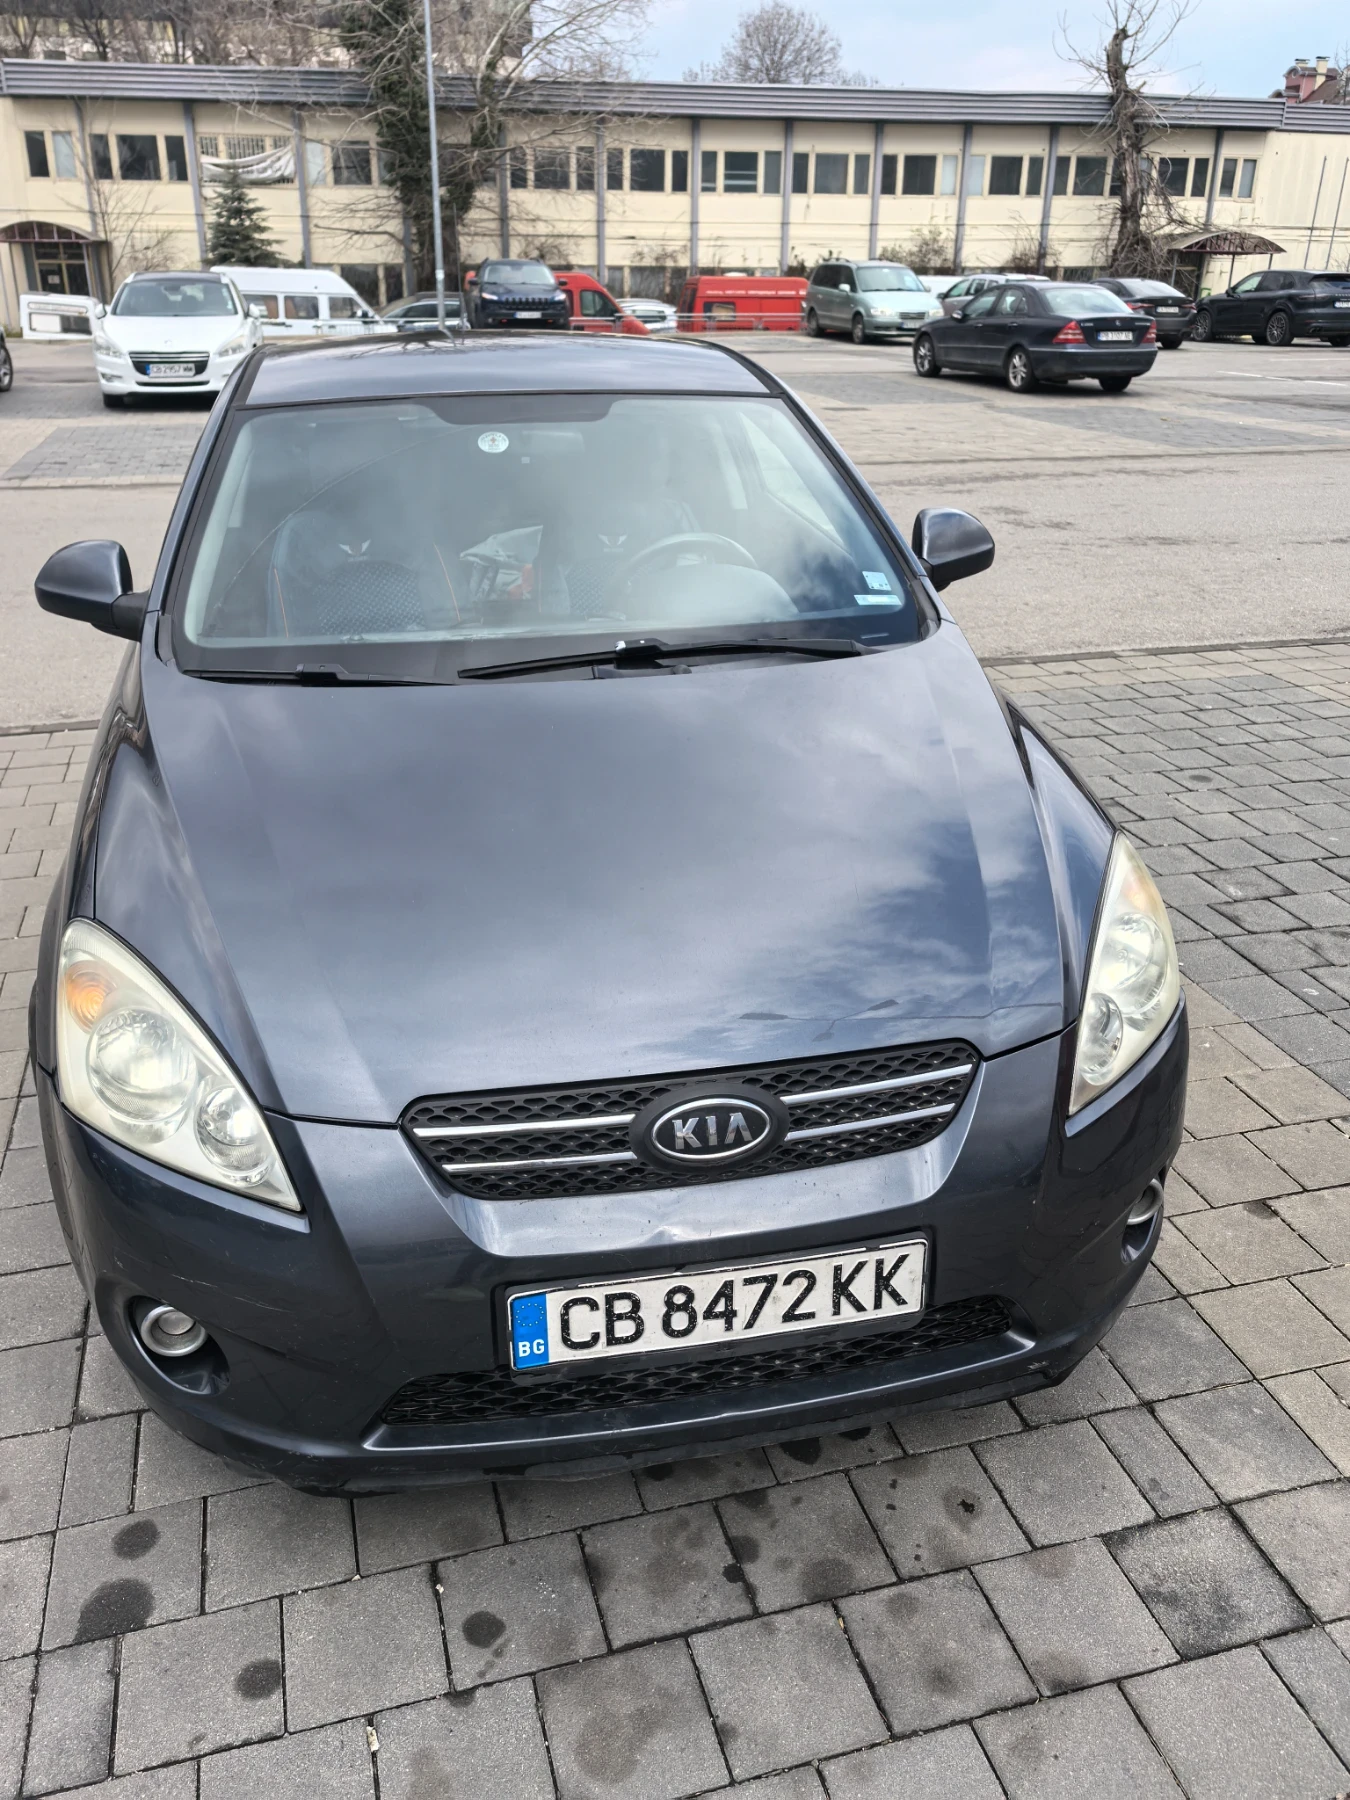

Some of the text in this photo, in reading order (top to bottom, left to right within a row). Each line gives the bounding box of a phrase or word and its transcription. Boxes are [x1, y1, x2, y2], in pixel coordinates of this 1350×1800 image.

[672, 1112, 753, 1149] KIA
[560, 1253, 911, 1351] CB 8472 KK
[518, 1338, 546, 1358] BG
